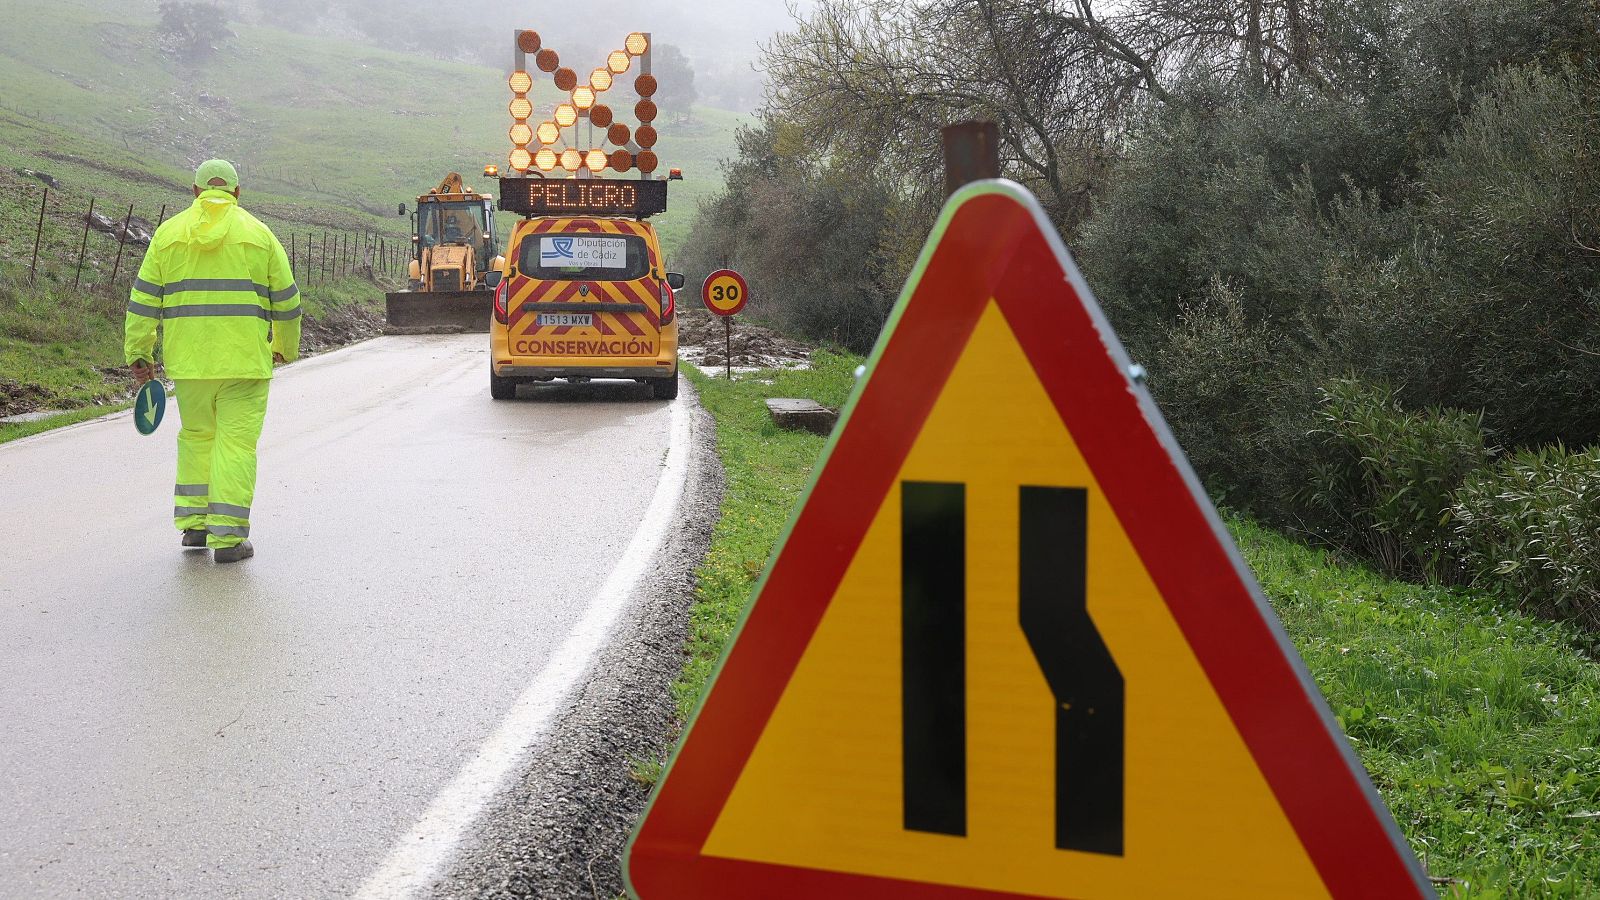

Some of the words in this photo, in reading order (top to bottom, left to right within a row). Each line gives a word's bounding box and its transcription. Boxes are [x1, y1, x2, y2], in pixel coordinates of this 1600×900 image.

[530, 184, 635, 207] PELIGRO
[577, 238, 626, 249] Diputación
[577, 250, 589, 259] de
[712, 285, 739, 301] 30
[544, 315, 568, 325] 1513
[571, 315, 590, 325] MXW
[516, 337, 653, 355] CONSERVACIÓN
